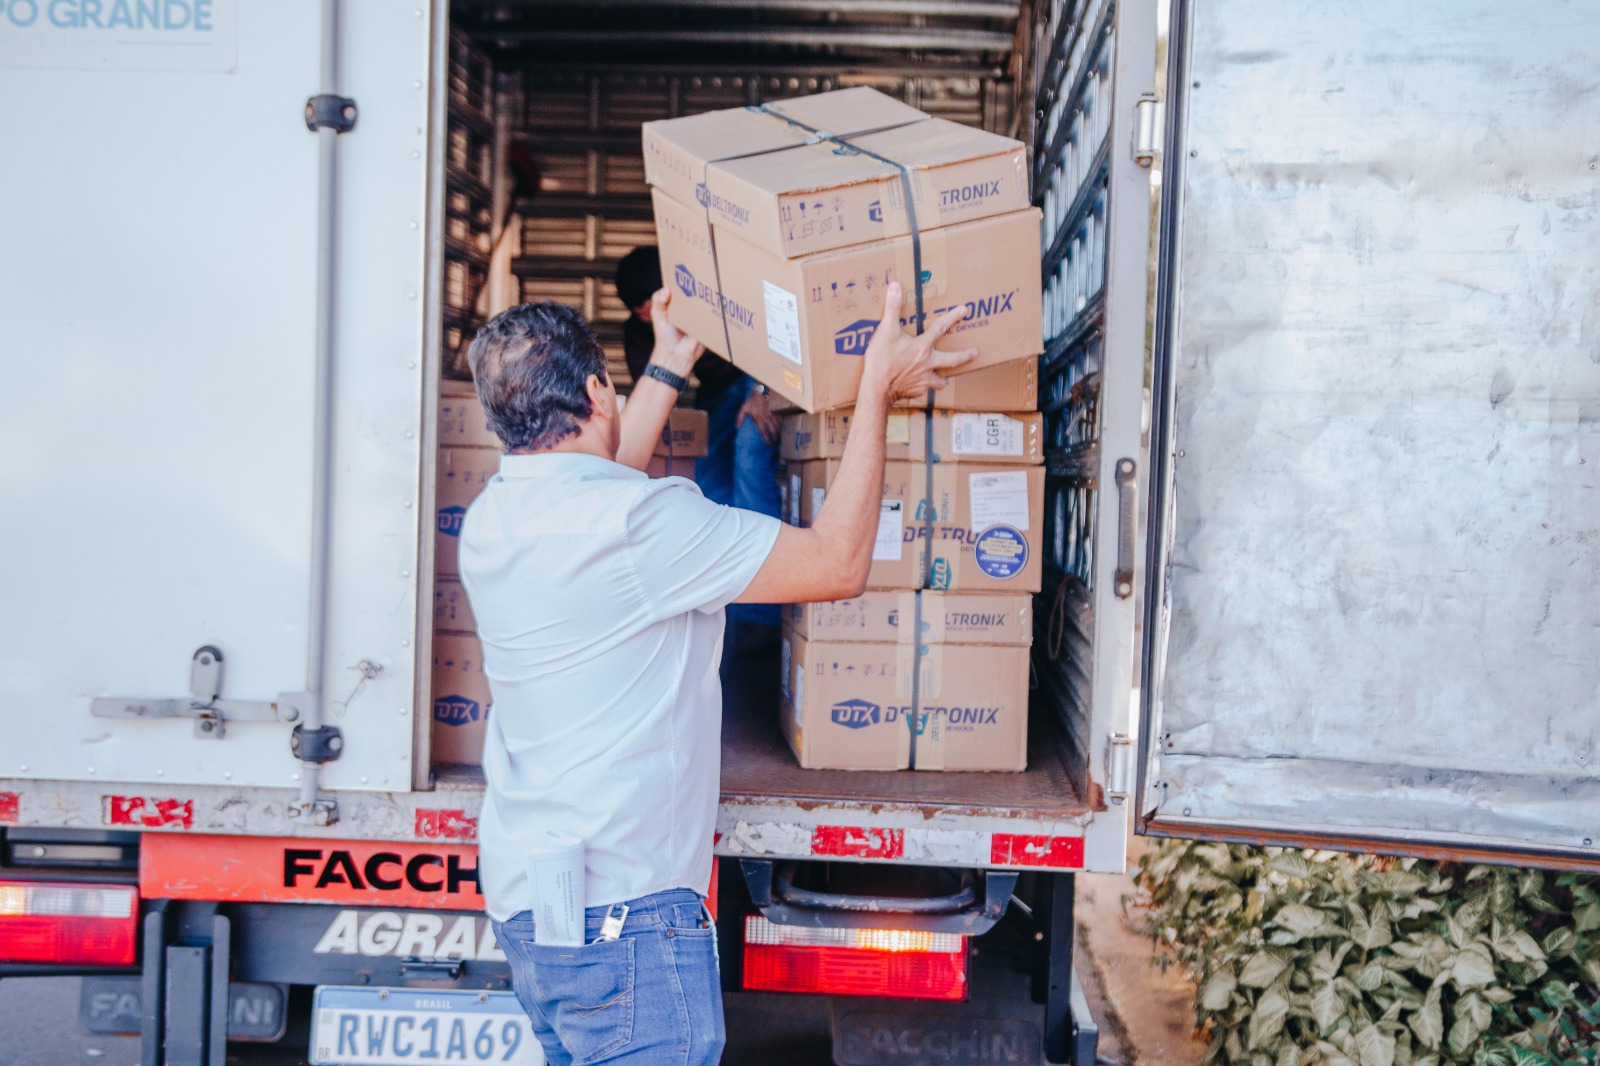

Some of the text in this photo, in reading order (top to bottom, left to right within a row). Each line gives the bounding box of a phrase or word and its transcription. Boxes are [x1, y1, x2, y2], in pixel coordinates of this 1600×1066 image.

[0, 0, 213, 31] O GRANDE
[938, 180, 1000, 206] TRONIX
[712, 194, 750, 224] DELTRONIX
[698, 281, 755, 330] DELTRONIX
[835, 325, 877, 352] DT
[956, 319, 990, 335] DEVICES
[987, 418, 1000, 447] CGR
[438, 513, 465, 530] DT
[945, 612, 1007, 627] LTRONIX
[434, 702, 477, 723] DTX
[832, 704, 878, 727] DTX
[283, 848, 482, 895] FACCH
[313, 909, 509, 962] AGRAL
[415, 998, 452, 1010] BRASIL
[337, 1013, 523, 1062] RWC1A69
[846, 1025, 1030, 1062] FACCHINI
[318, 1047, 331, 1060] BR
